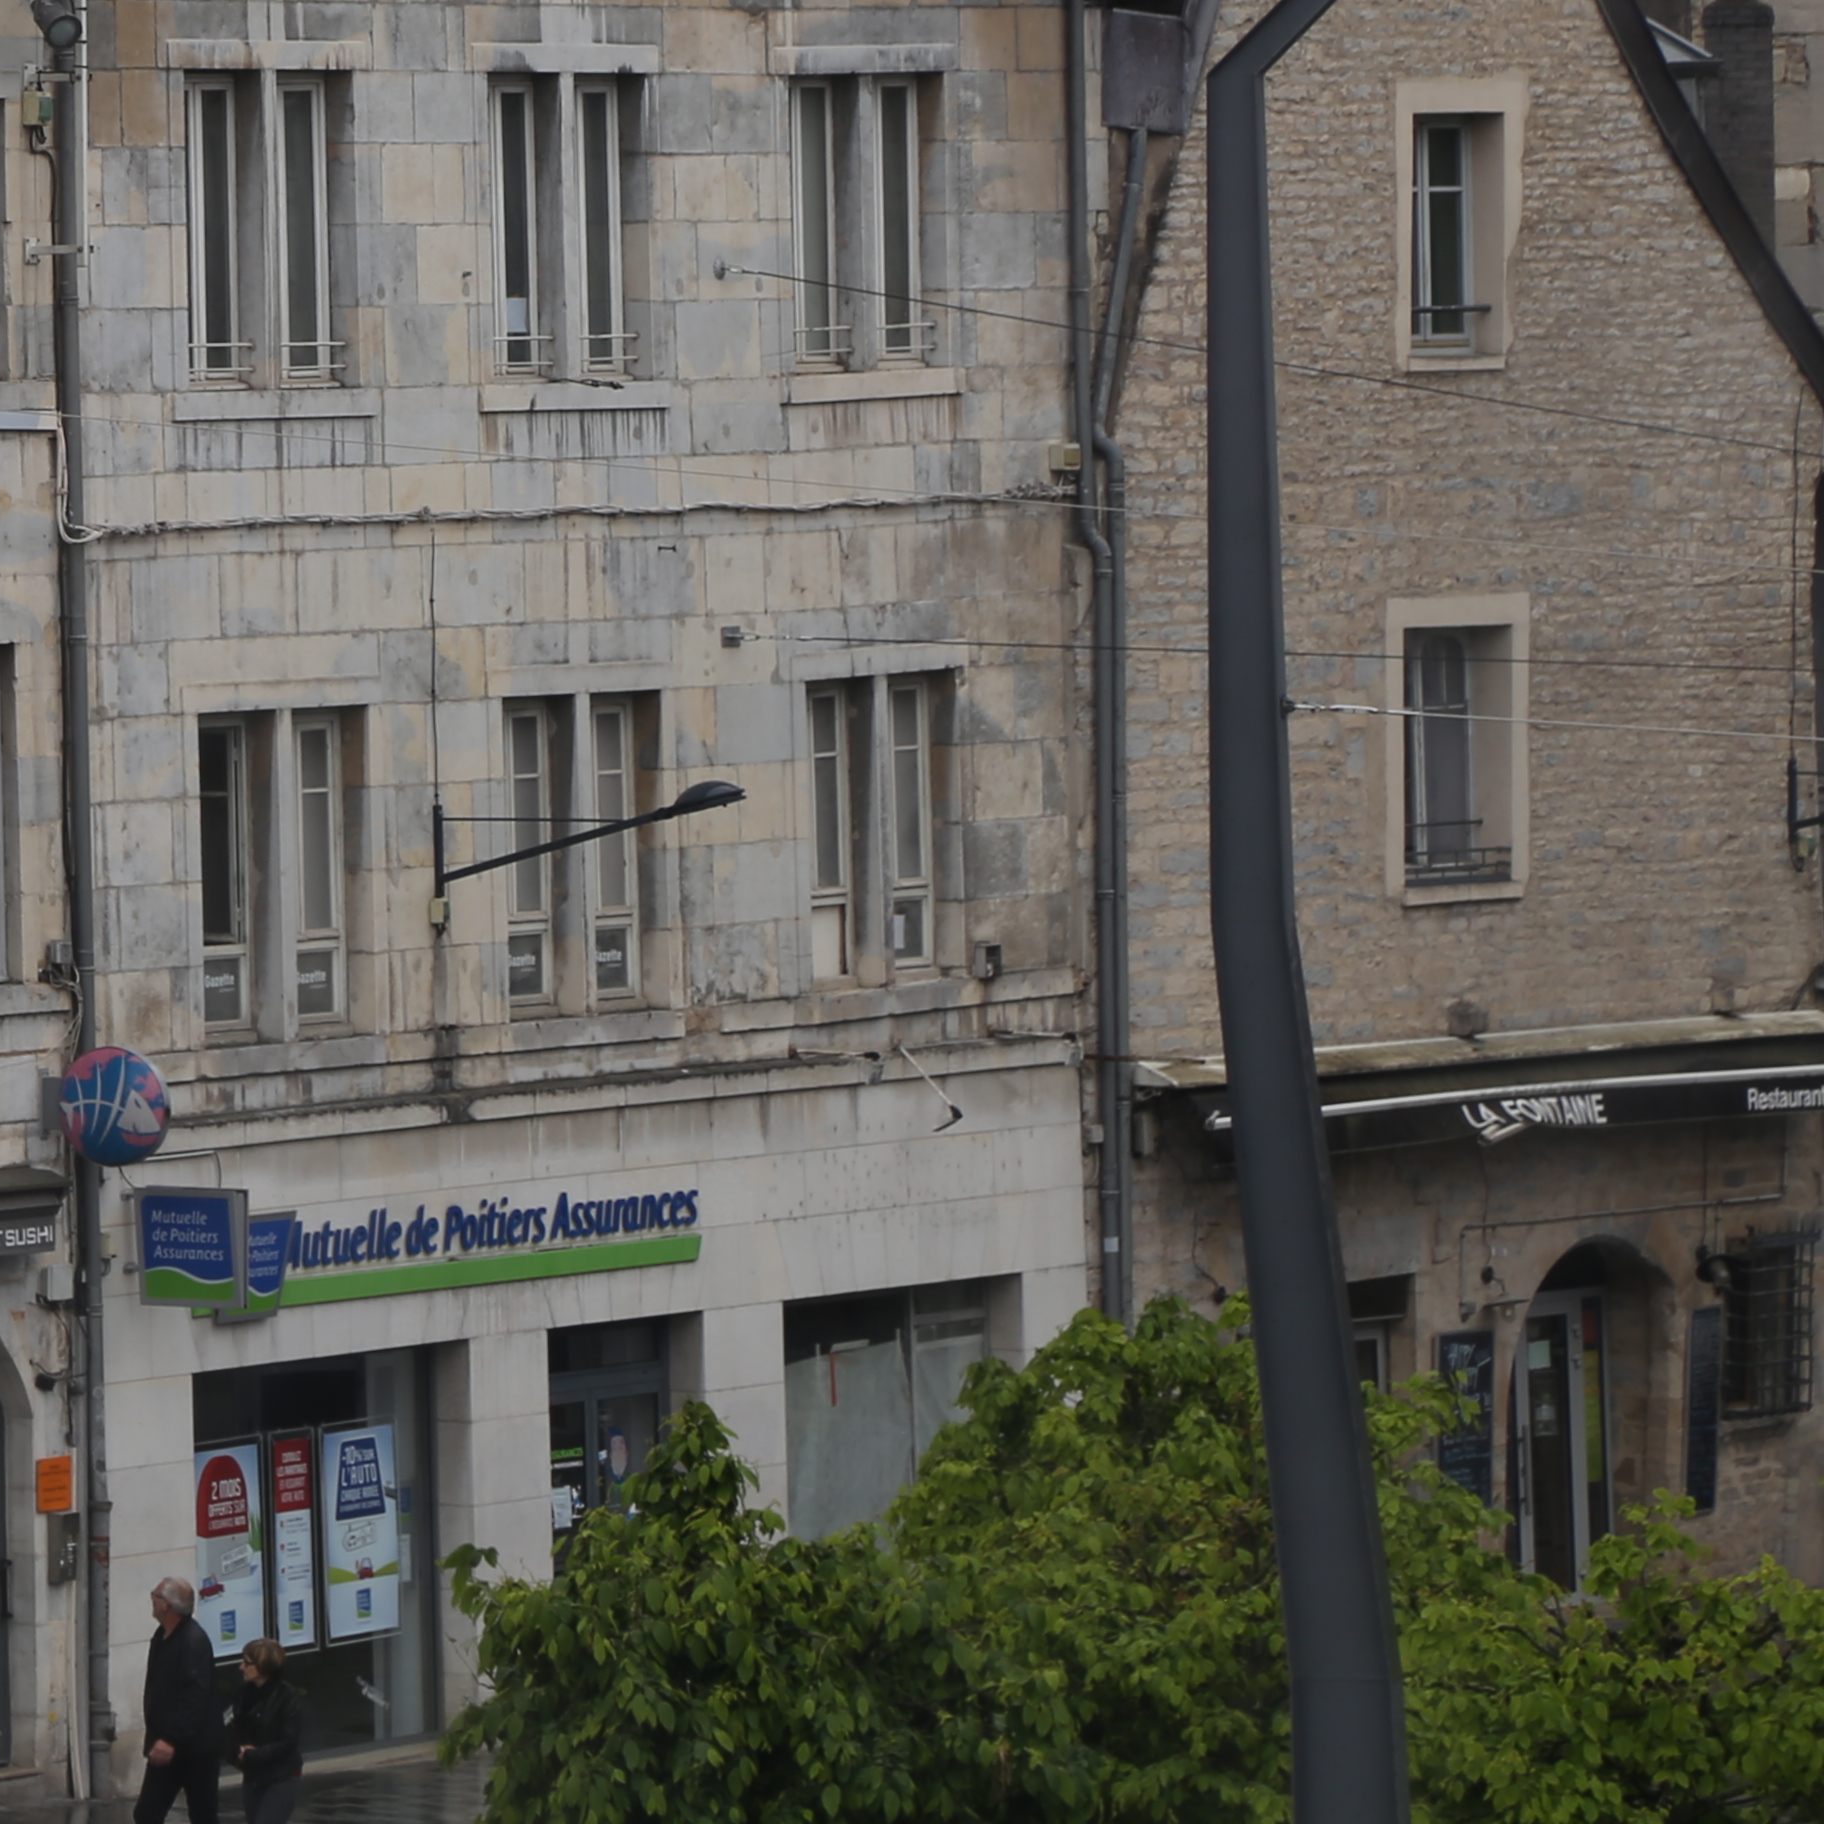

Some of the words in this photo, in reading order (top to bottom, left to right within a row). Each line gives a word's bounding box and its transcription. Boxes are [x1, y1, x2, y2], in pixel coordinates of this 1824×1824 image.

[1461, 1102, 1506, 1129] LA
[1500, 1094, 1608, 1125] FONTAINE
[152, 1210, 208, 1225] Mutuelle
[406, 1205, 440, 1256] de
[443, 1197, 547, 1252] Poitiers
[551, 1189, 699, 1240] Assurances
[5, 1225, 53, 1247] SUSHI
[153, 1228, 167, 1242] de
[170, 1228, 219, 1244] Poitiers
[154, 1245, 224, 1261] Assurances
[211, 1481, 219, 1501] 2
